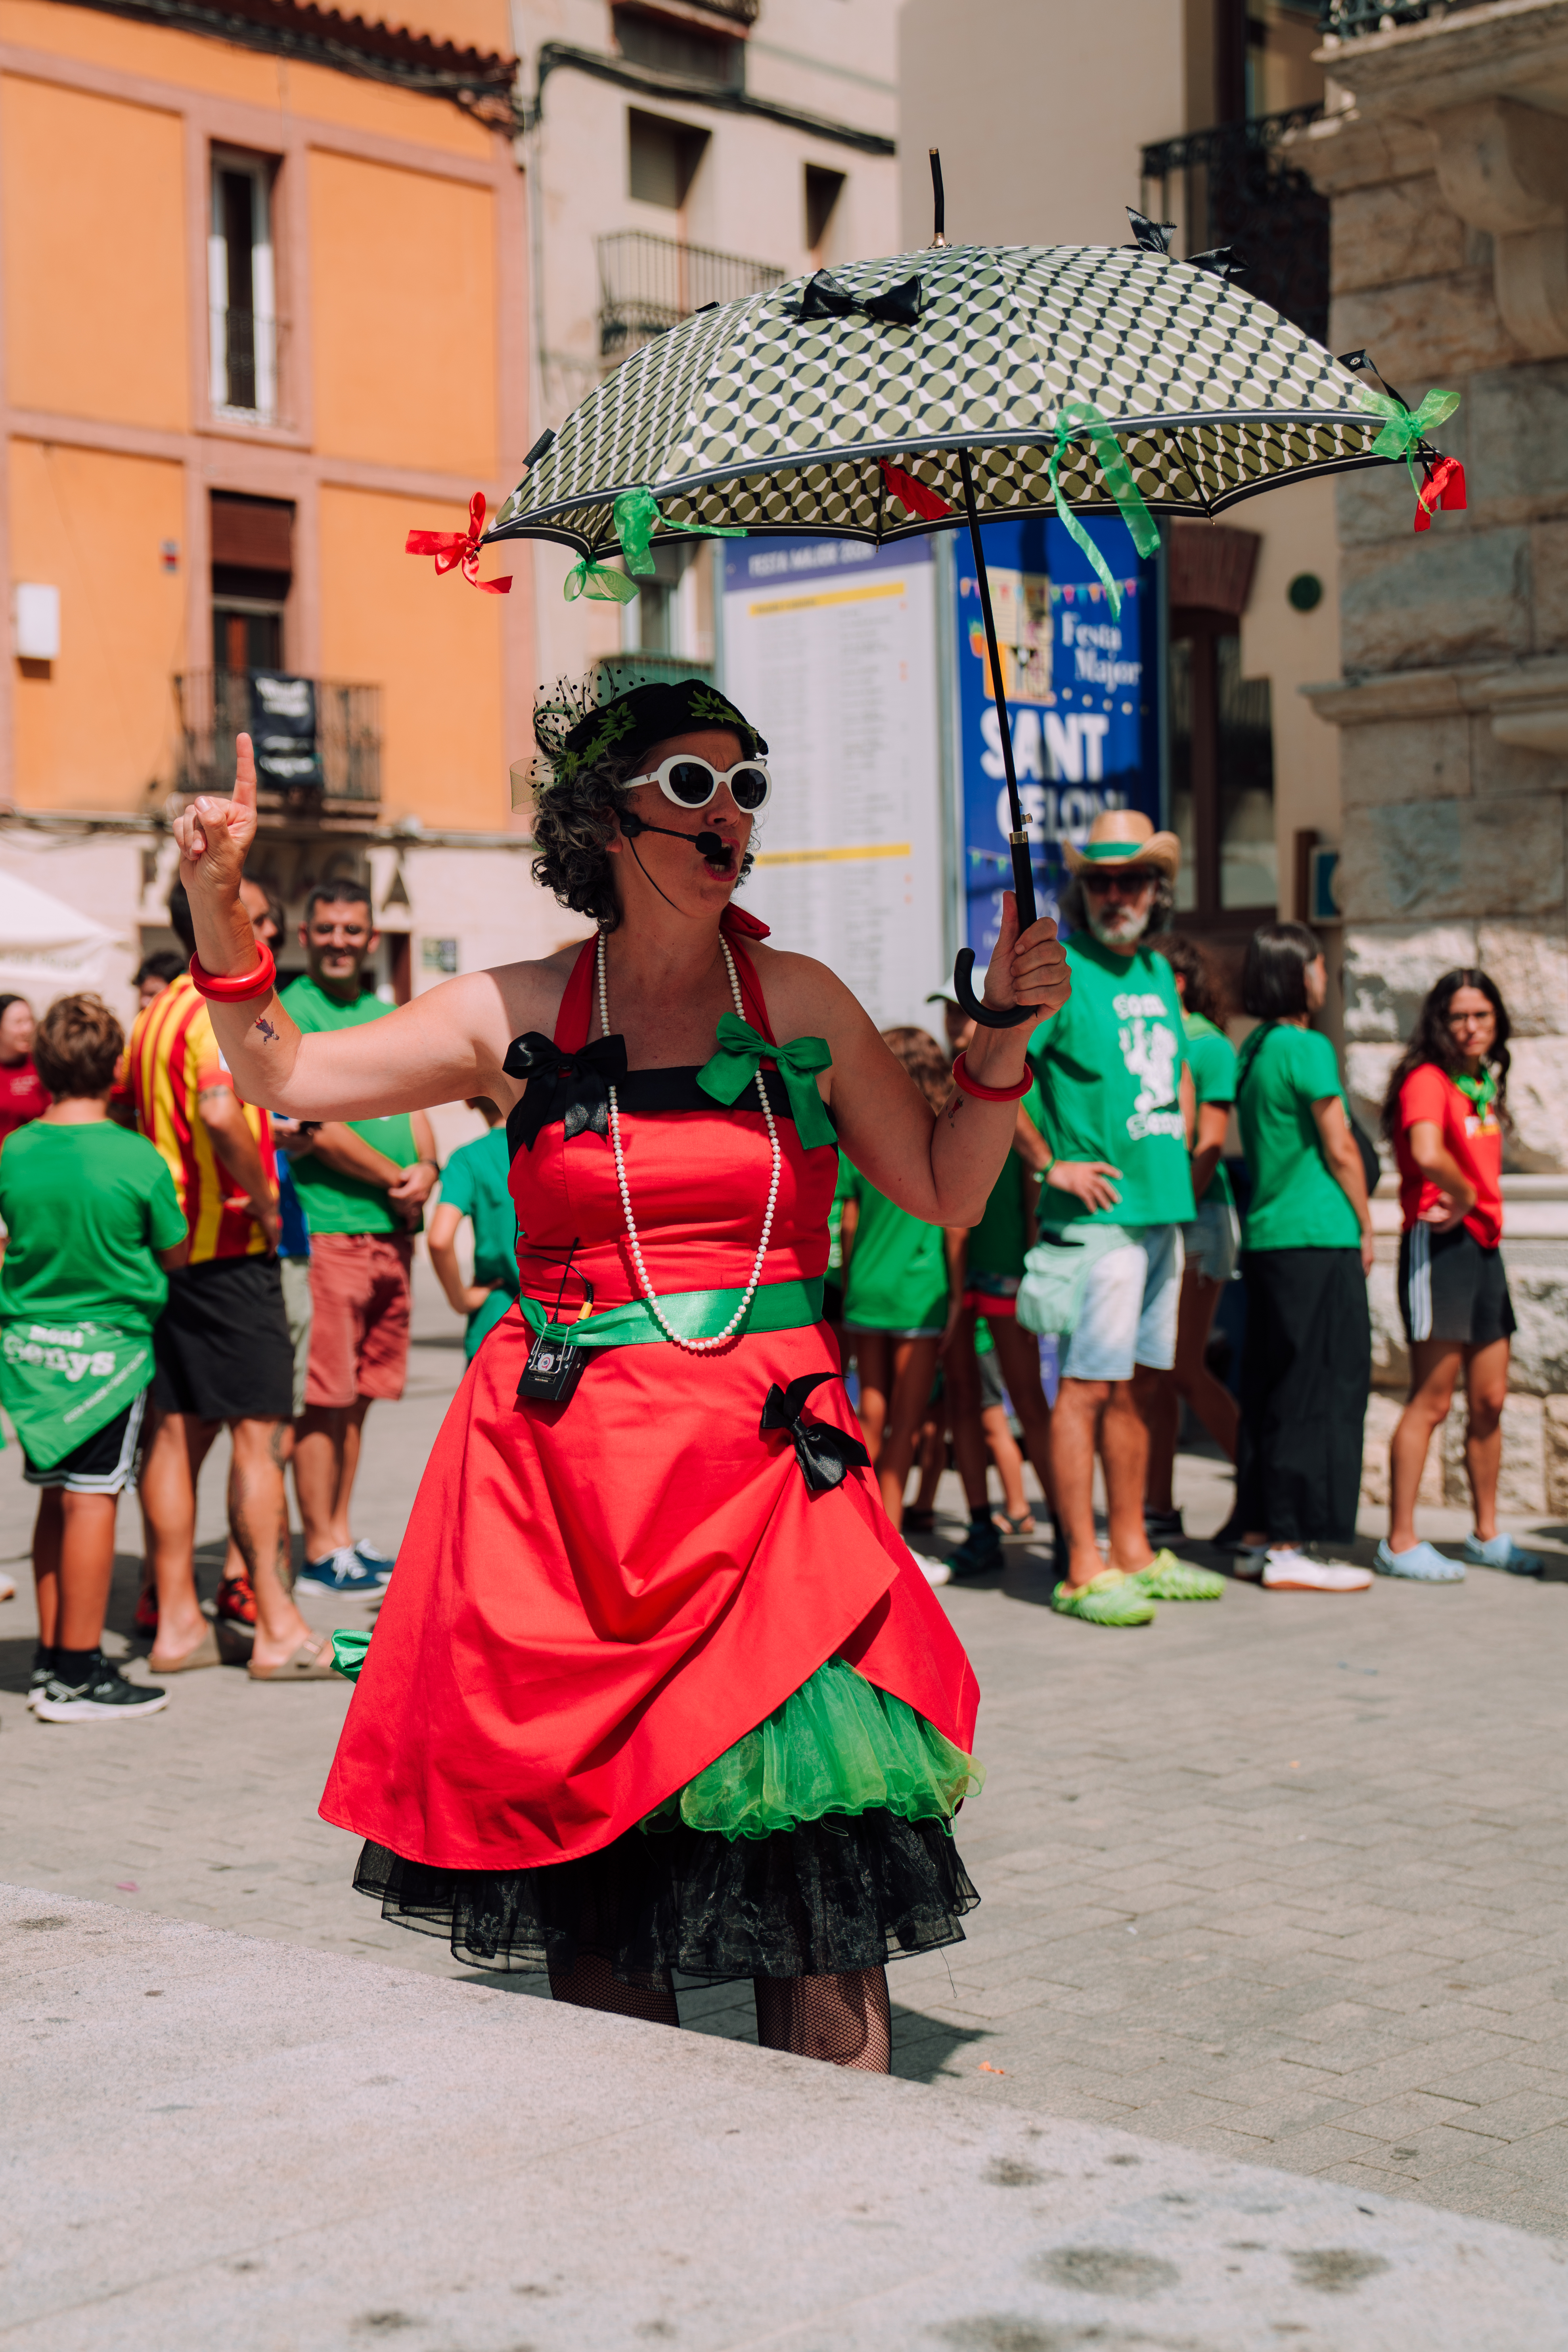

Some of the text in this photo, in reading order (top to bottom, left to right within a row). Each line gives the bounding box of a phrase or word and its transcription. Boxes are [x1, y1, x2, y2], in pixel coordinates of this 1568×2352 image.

[1061, 611, 1122, 651] Festa
[1075, 648, 1142, 693] Major
[980, 706, 1109, 783] SANT
[3, 1335, 116, 1382] Senys
